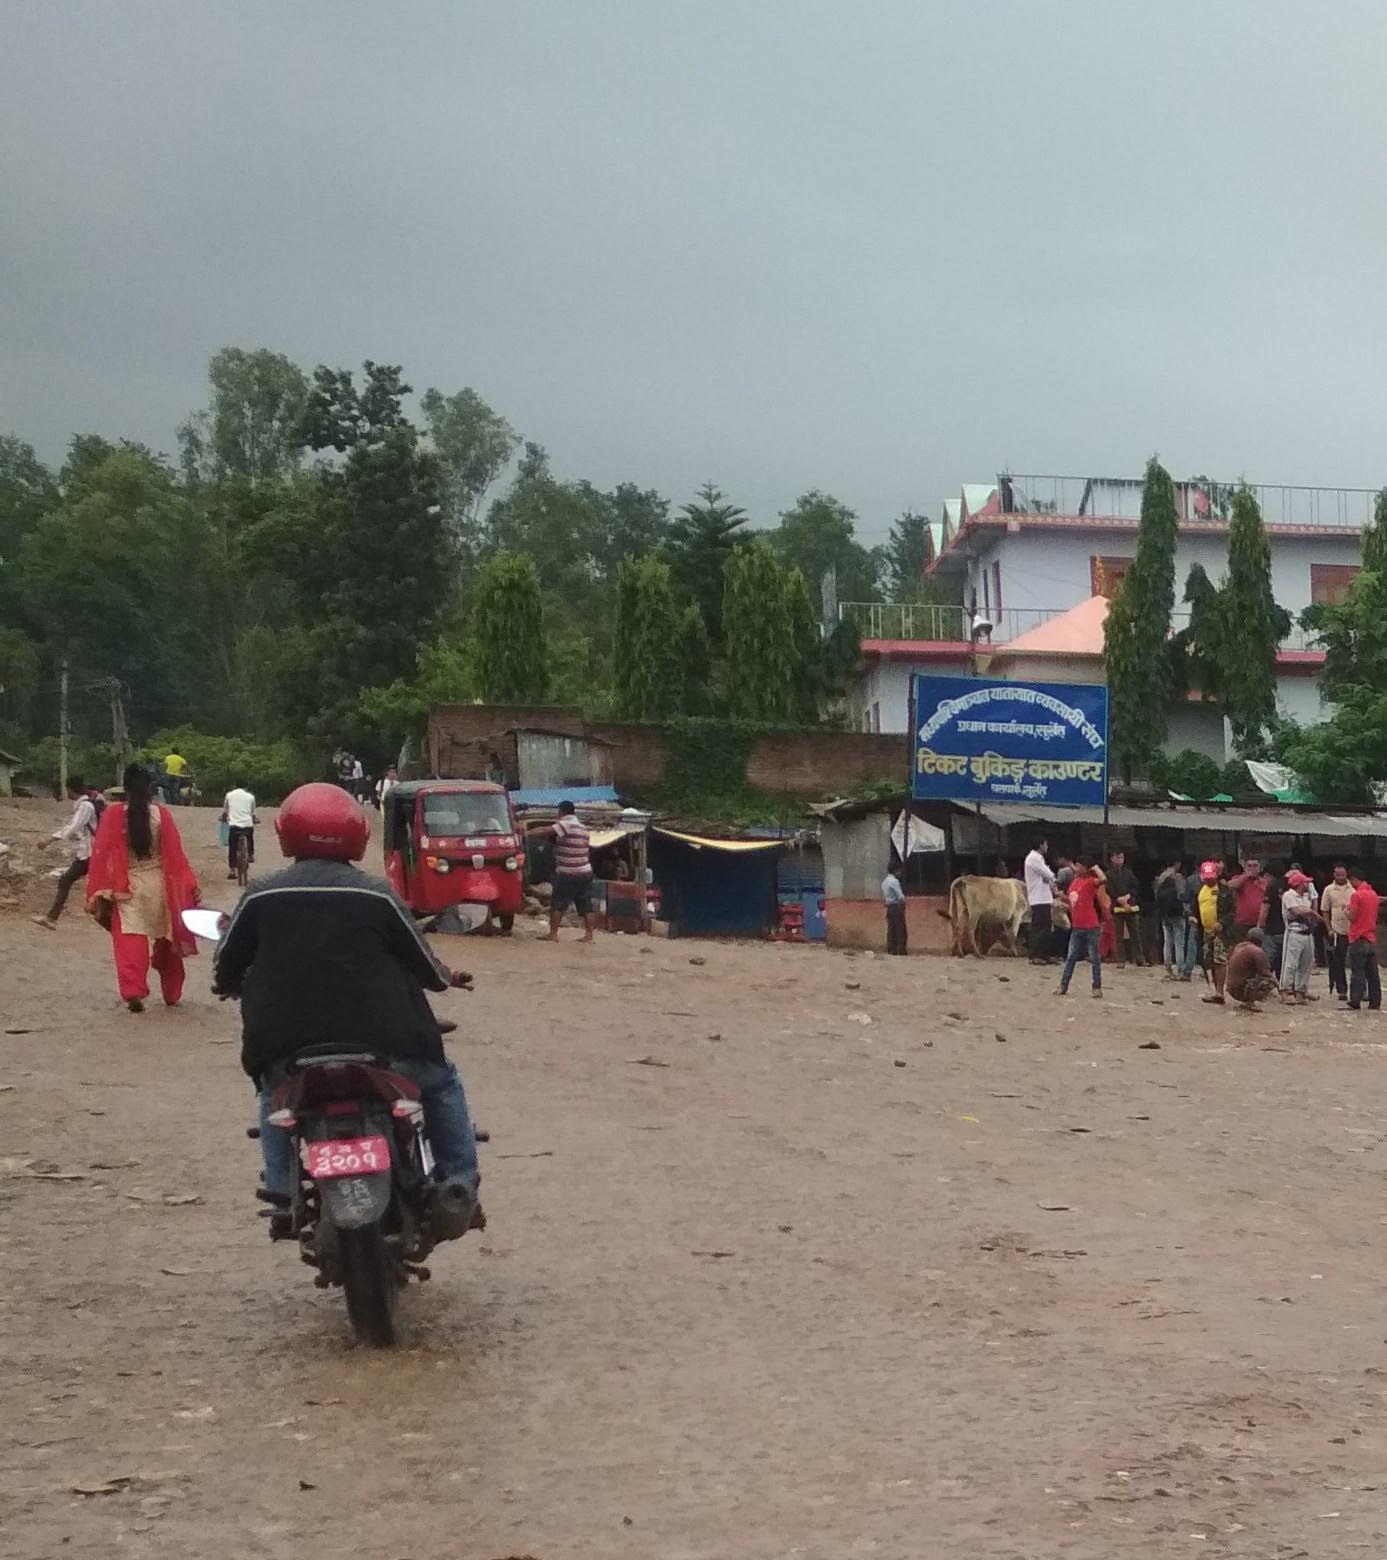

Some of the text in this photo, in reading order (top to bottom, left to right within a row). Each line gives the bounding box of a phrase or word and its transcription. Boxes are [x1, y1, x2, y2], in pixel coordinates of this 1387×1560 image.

[990, 687, 1036, 704] यातायात
[957, 720, 986, 733] प्रधान
[917, 747, 968, 775] टिकट
